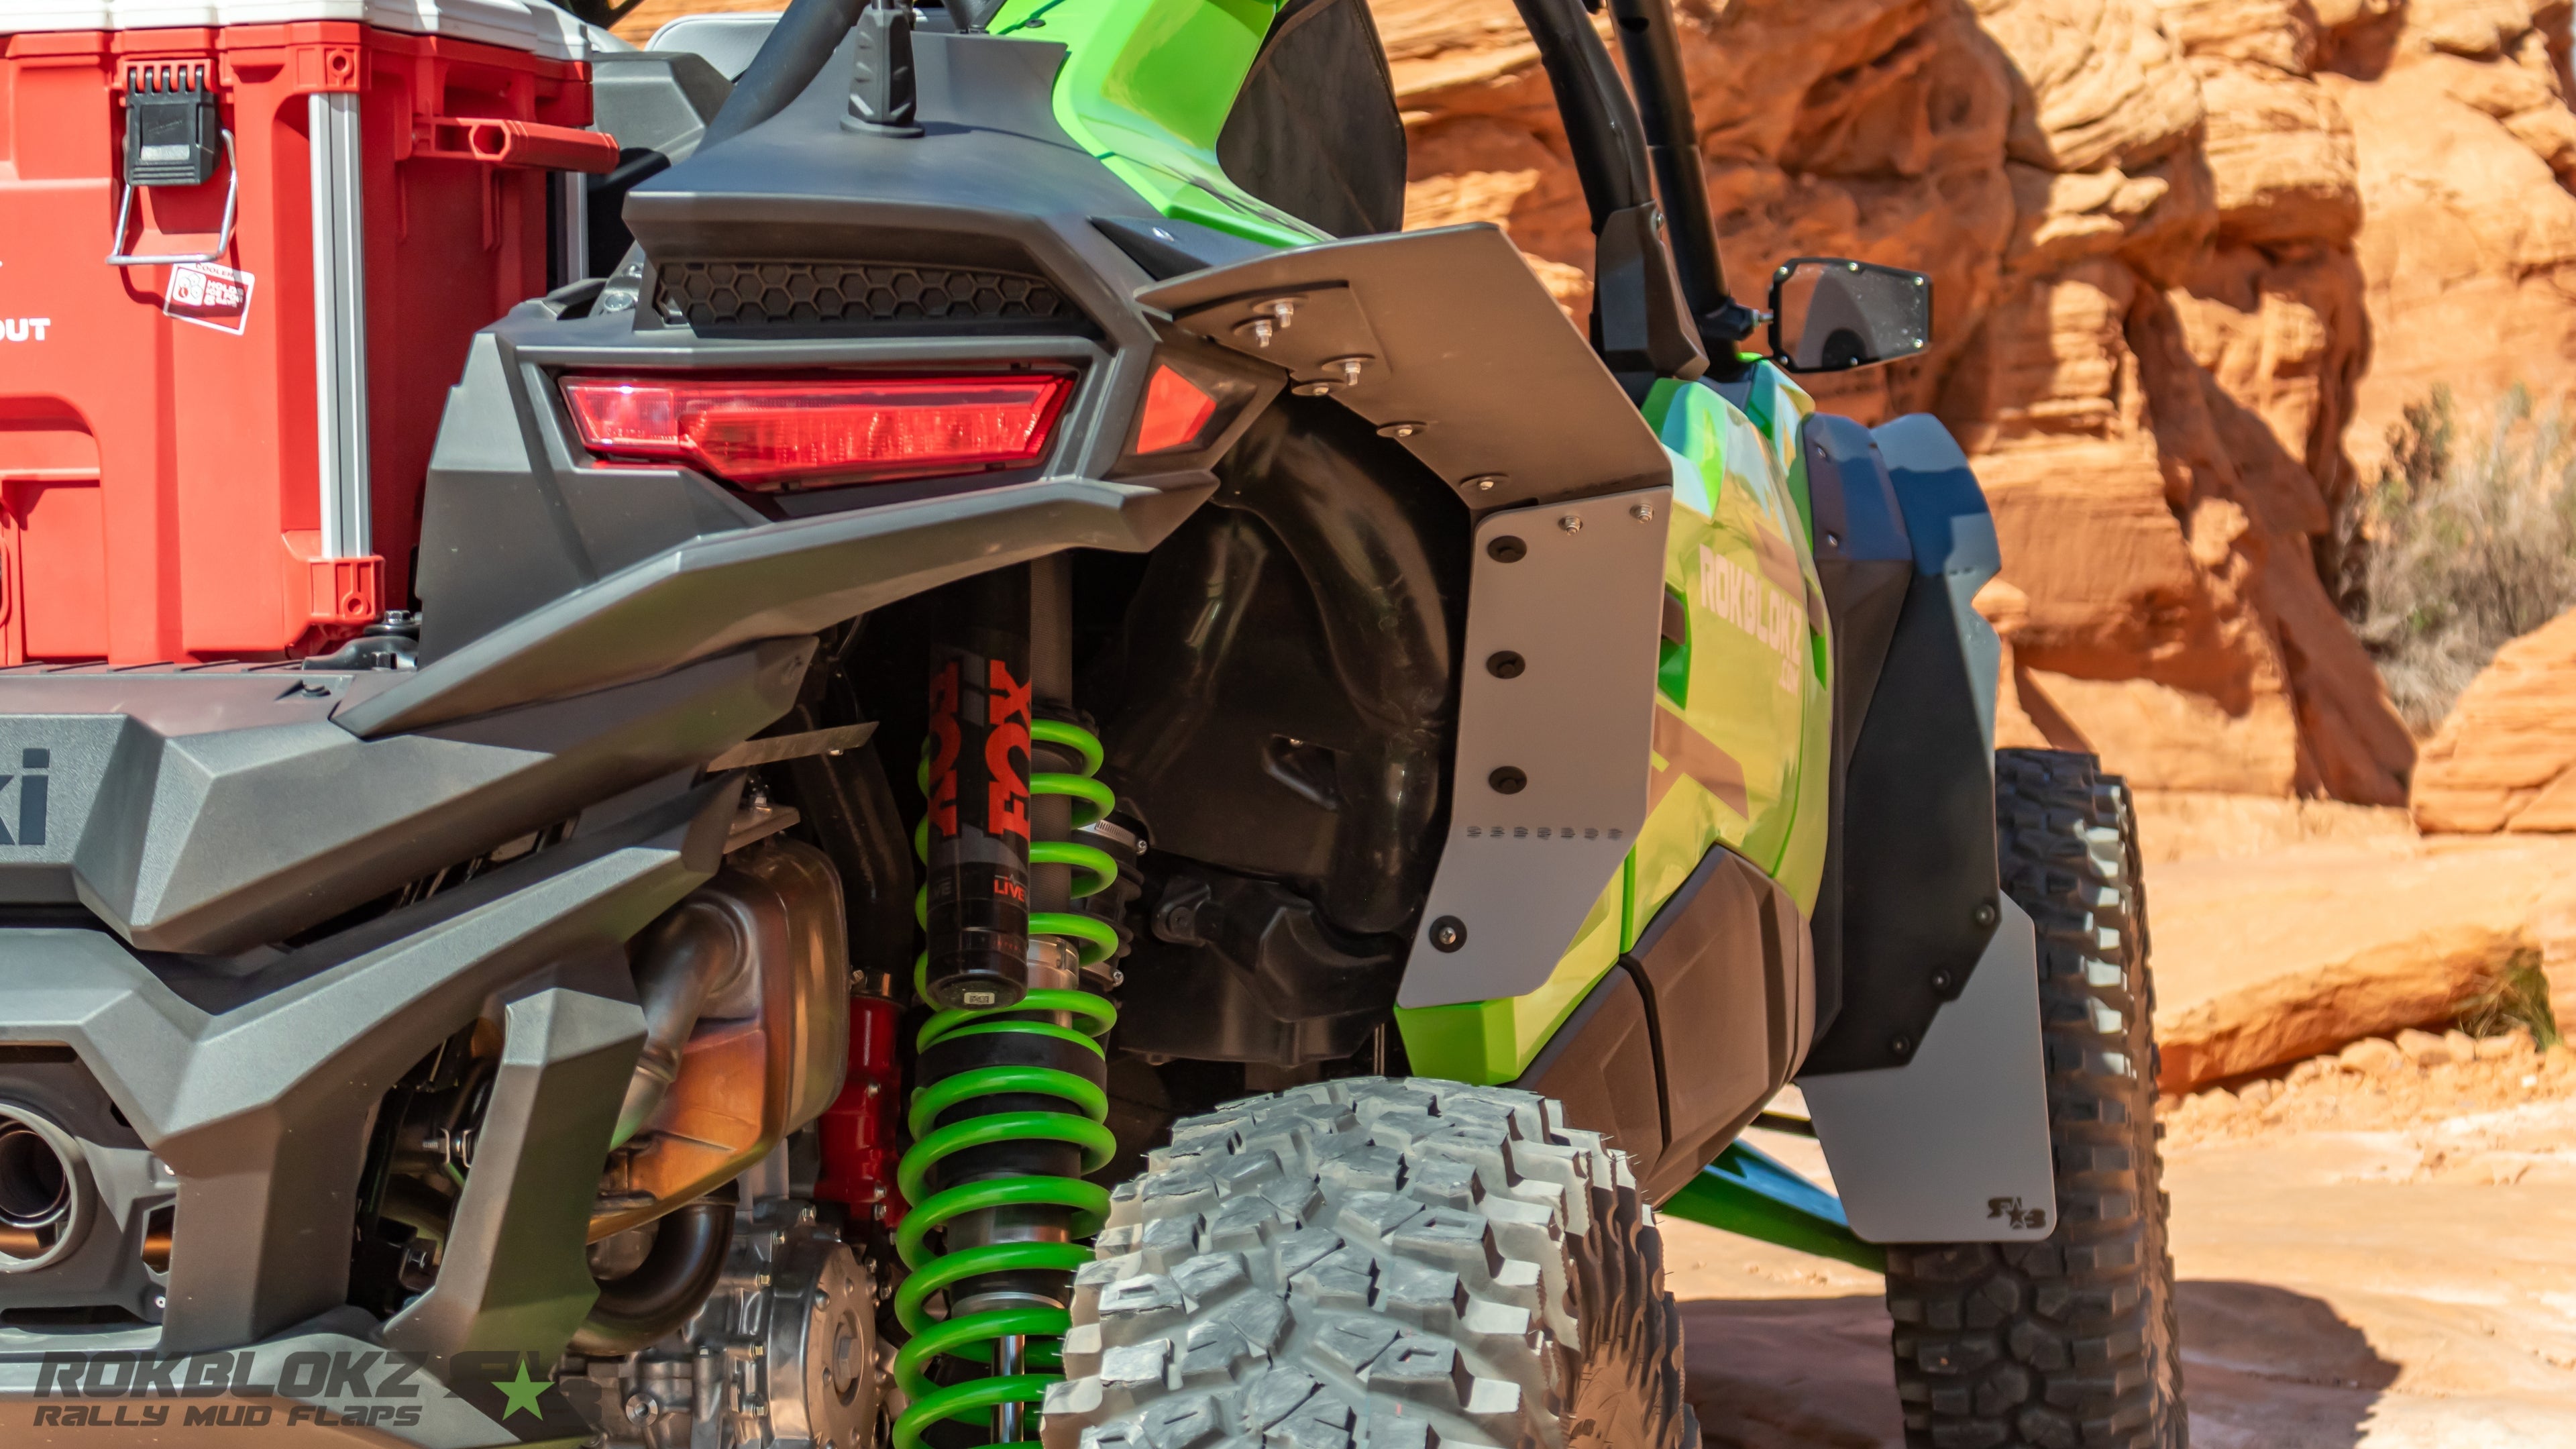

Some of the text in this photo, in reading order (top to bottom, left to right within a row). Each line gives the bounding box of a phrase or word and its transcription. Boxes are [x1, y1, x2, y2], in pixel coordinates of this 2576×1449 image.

[1699, 543, 1803, 667] ROKBLOKZ
[985, 659, 1031, 842] FOX
[994, 877, 1025, 902] LIVE
